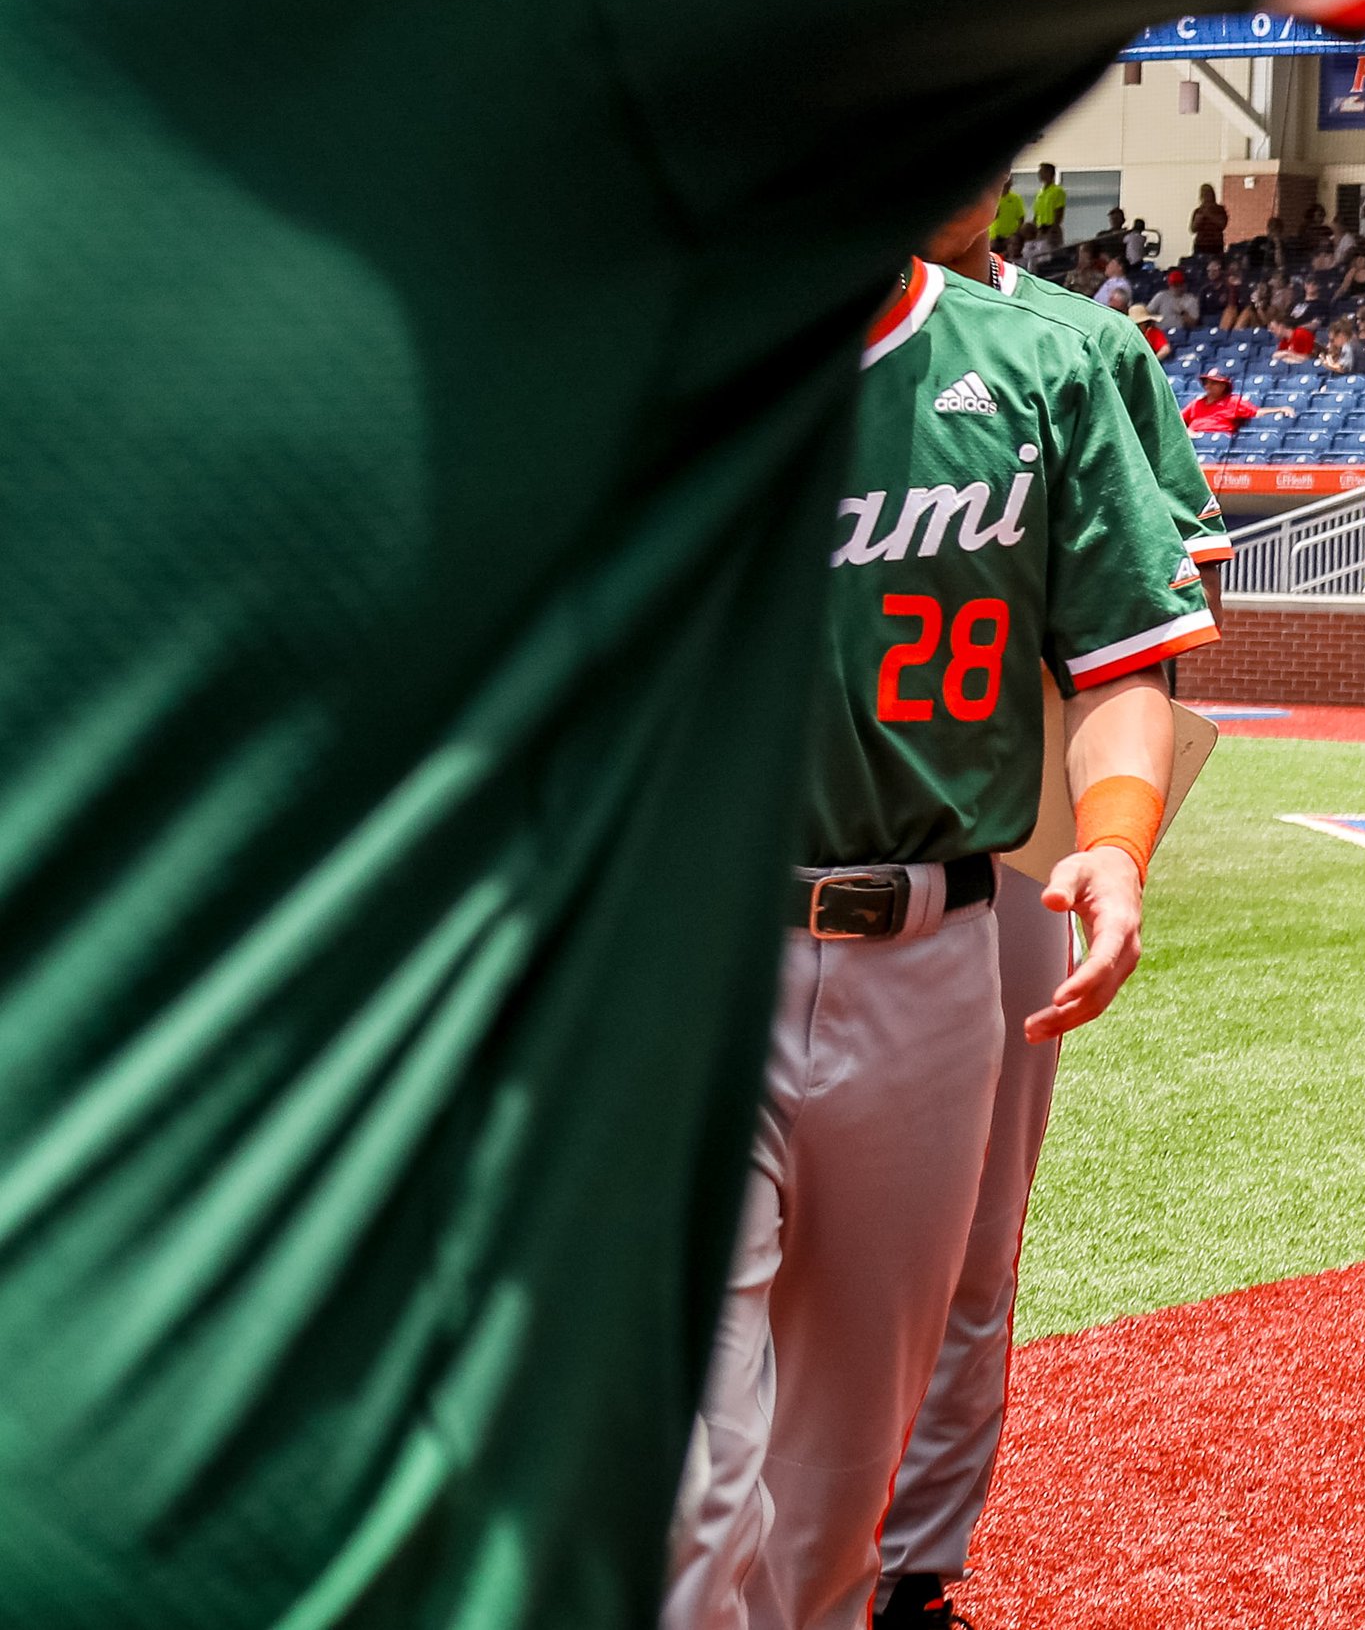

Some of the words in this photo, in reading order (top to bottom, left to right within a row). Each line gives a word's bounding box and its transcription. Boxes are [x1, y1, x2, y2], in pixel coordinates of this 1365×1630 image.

[1176, 15, 1198, 40] C
[934, 395, 998, 415] adidas
[876, 593, 1010, 722] 28
